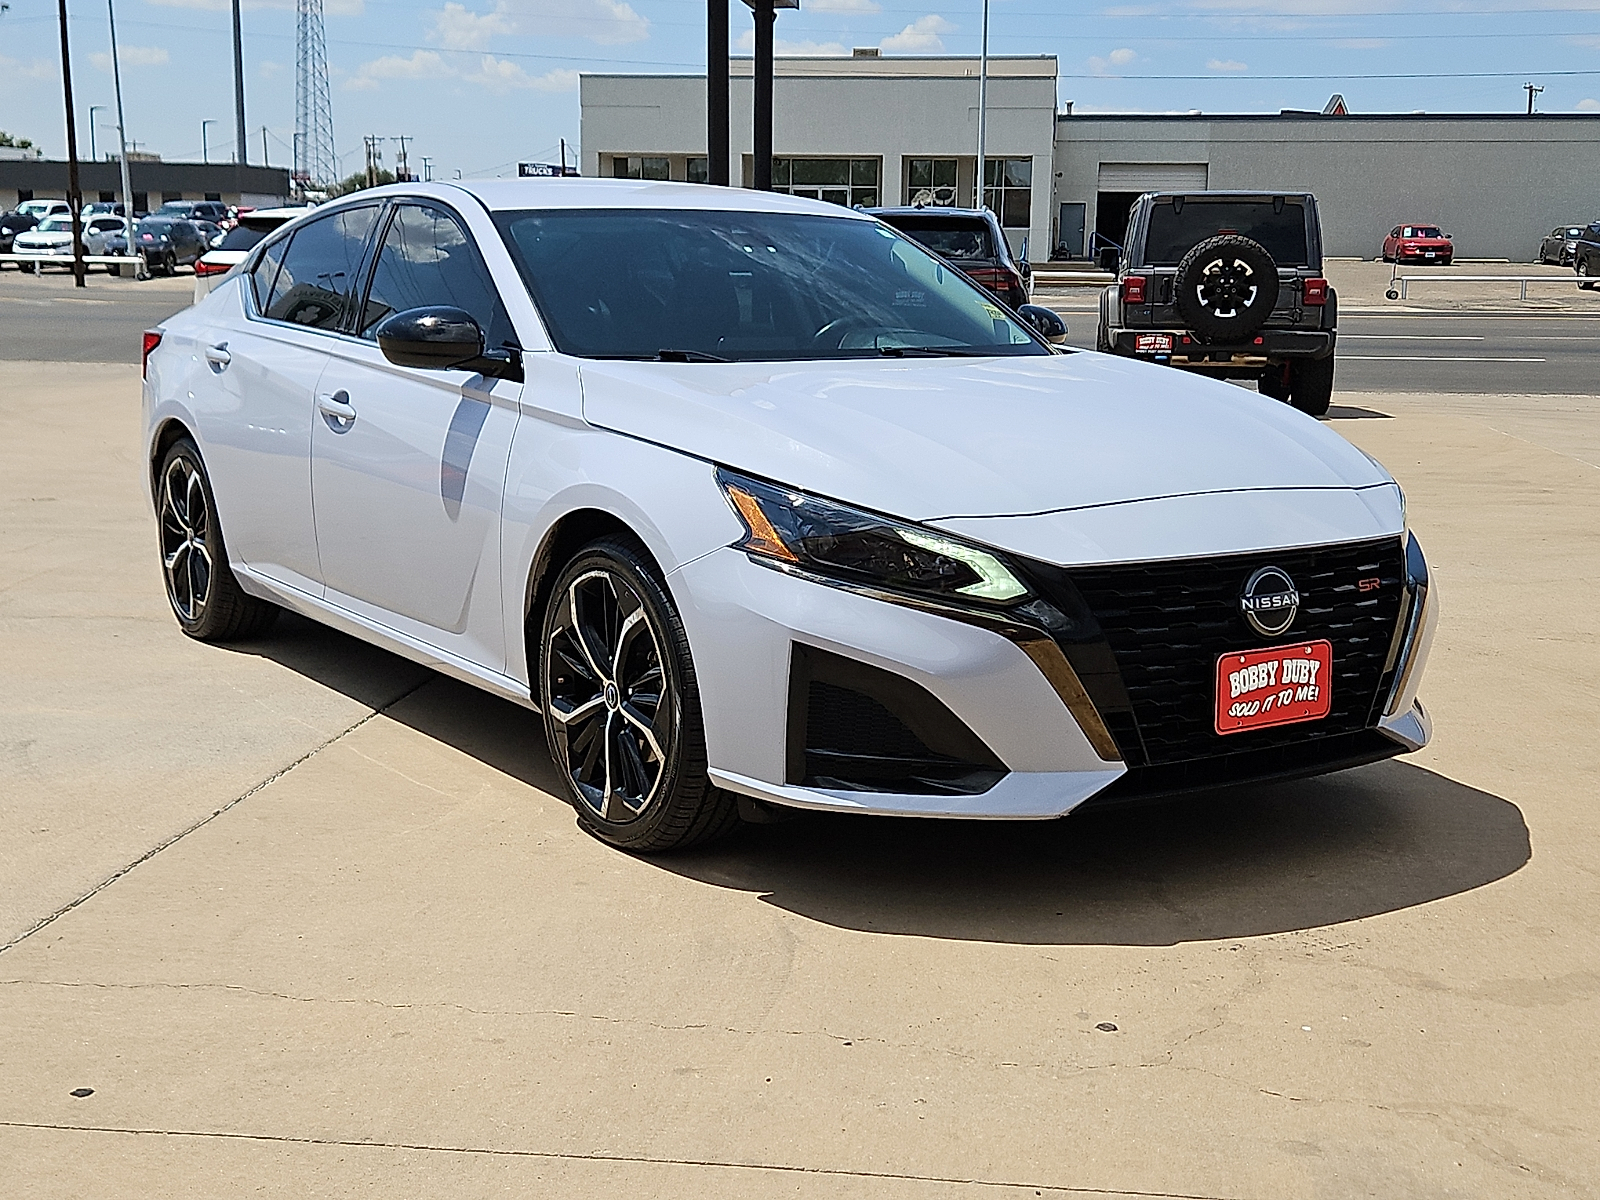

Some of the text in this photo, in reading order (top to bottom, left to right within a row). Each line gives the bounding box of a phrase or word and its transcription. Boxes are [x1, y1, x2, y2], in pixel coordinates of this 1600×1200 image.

[1358, 577, 1381, 593] SR
[1241, 592, 1300, 610] NISSAN
[1229, 659, 1321, 699] BOBBY DUBY
[1228, 685, 1320, 717] SOLD IT TO ME!
